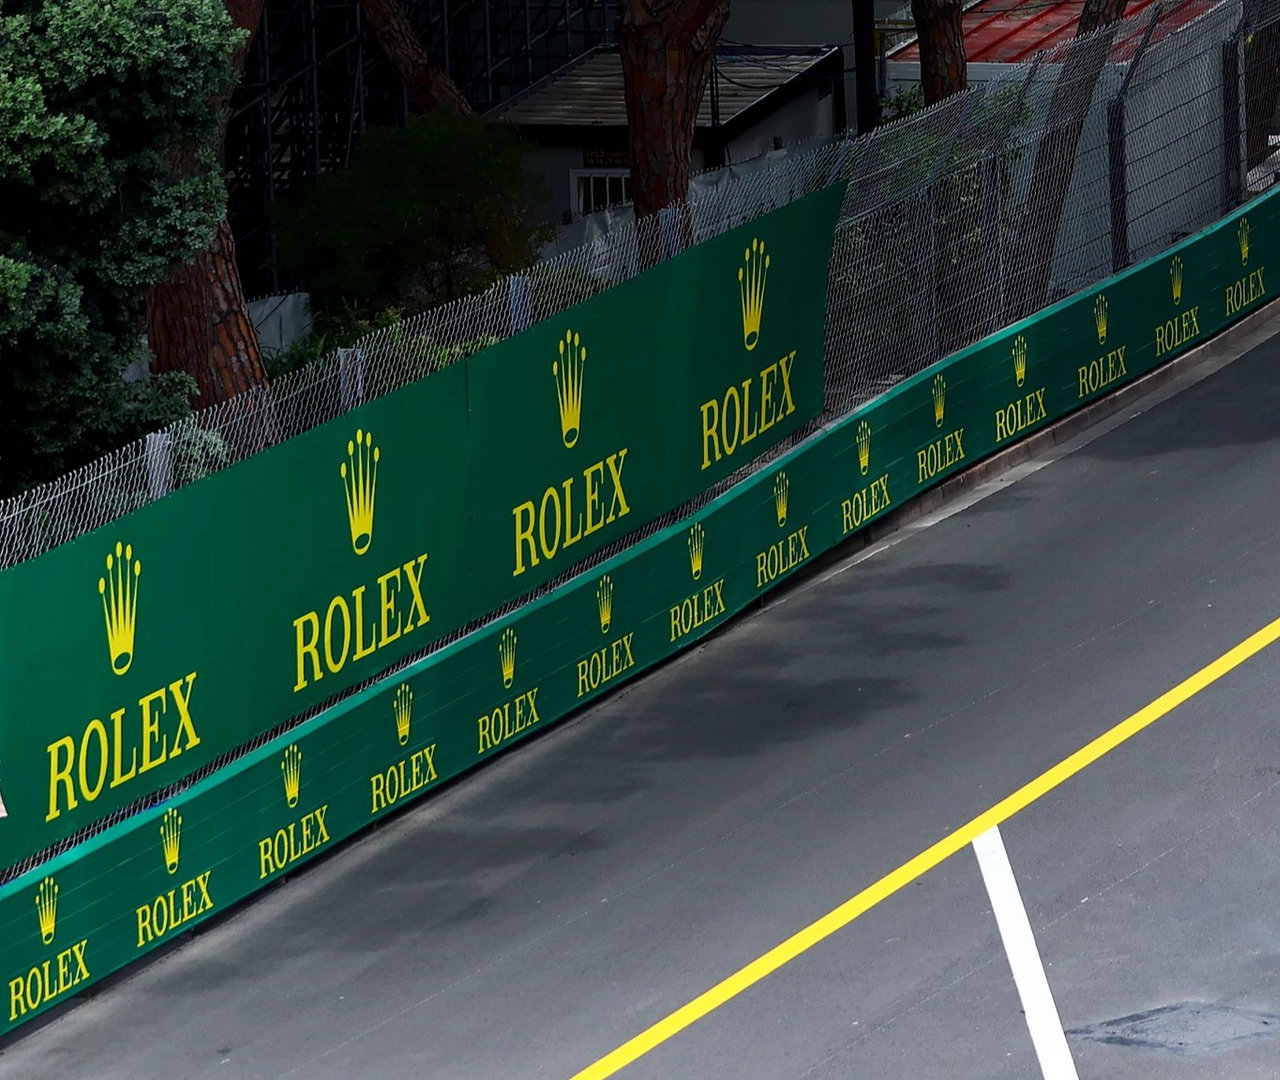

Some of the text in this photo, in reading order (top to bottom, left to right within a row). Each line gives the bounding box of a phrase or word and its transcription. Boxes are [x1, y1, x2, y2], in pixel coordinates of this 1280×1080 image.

[1224, 267, 1266, 318] ROLEX
[1154, 307, 1201, 357] ROLEX
[1077, 347, 1128, 398] ROLEX
[700, 351, 796, 470] ROLEX
[995, 388, 1048, 443] ROLEX
[917, 428, 965, 484] ROLEX
[512, 449, 630, 576] ROLEX
[841, 474, 891, 533] ROLEX
[756, 525, 810, 588] ROLEX
[293, 554, 430, 692] ROLEX
[670, 577, 726, 643] ROLEX
[576, 632, 635, 697] ROLEX
[45, 672, 201, 821] ROLEX
[477, 688, 540, 754] ROLEX
[370, 744, 438, 813] ROLEX
[259, 804, 330, 878] ROLEX
[136, 869, 214, 947] ROLEX
[9, 939, 90, 1020] ROLEX
